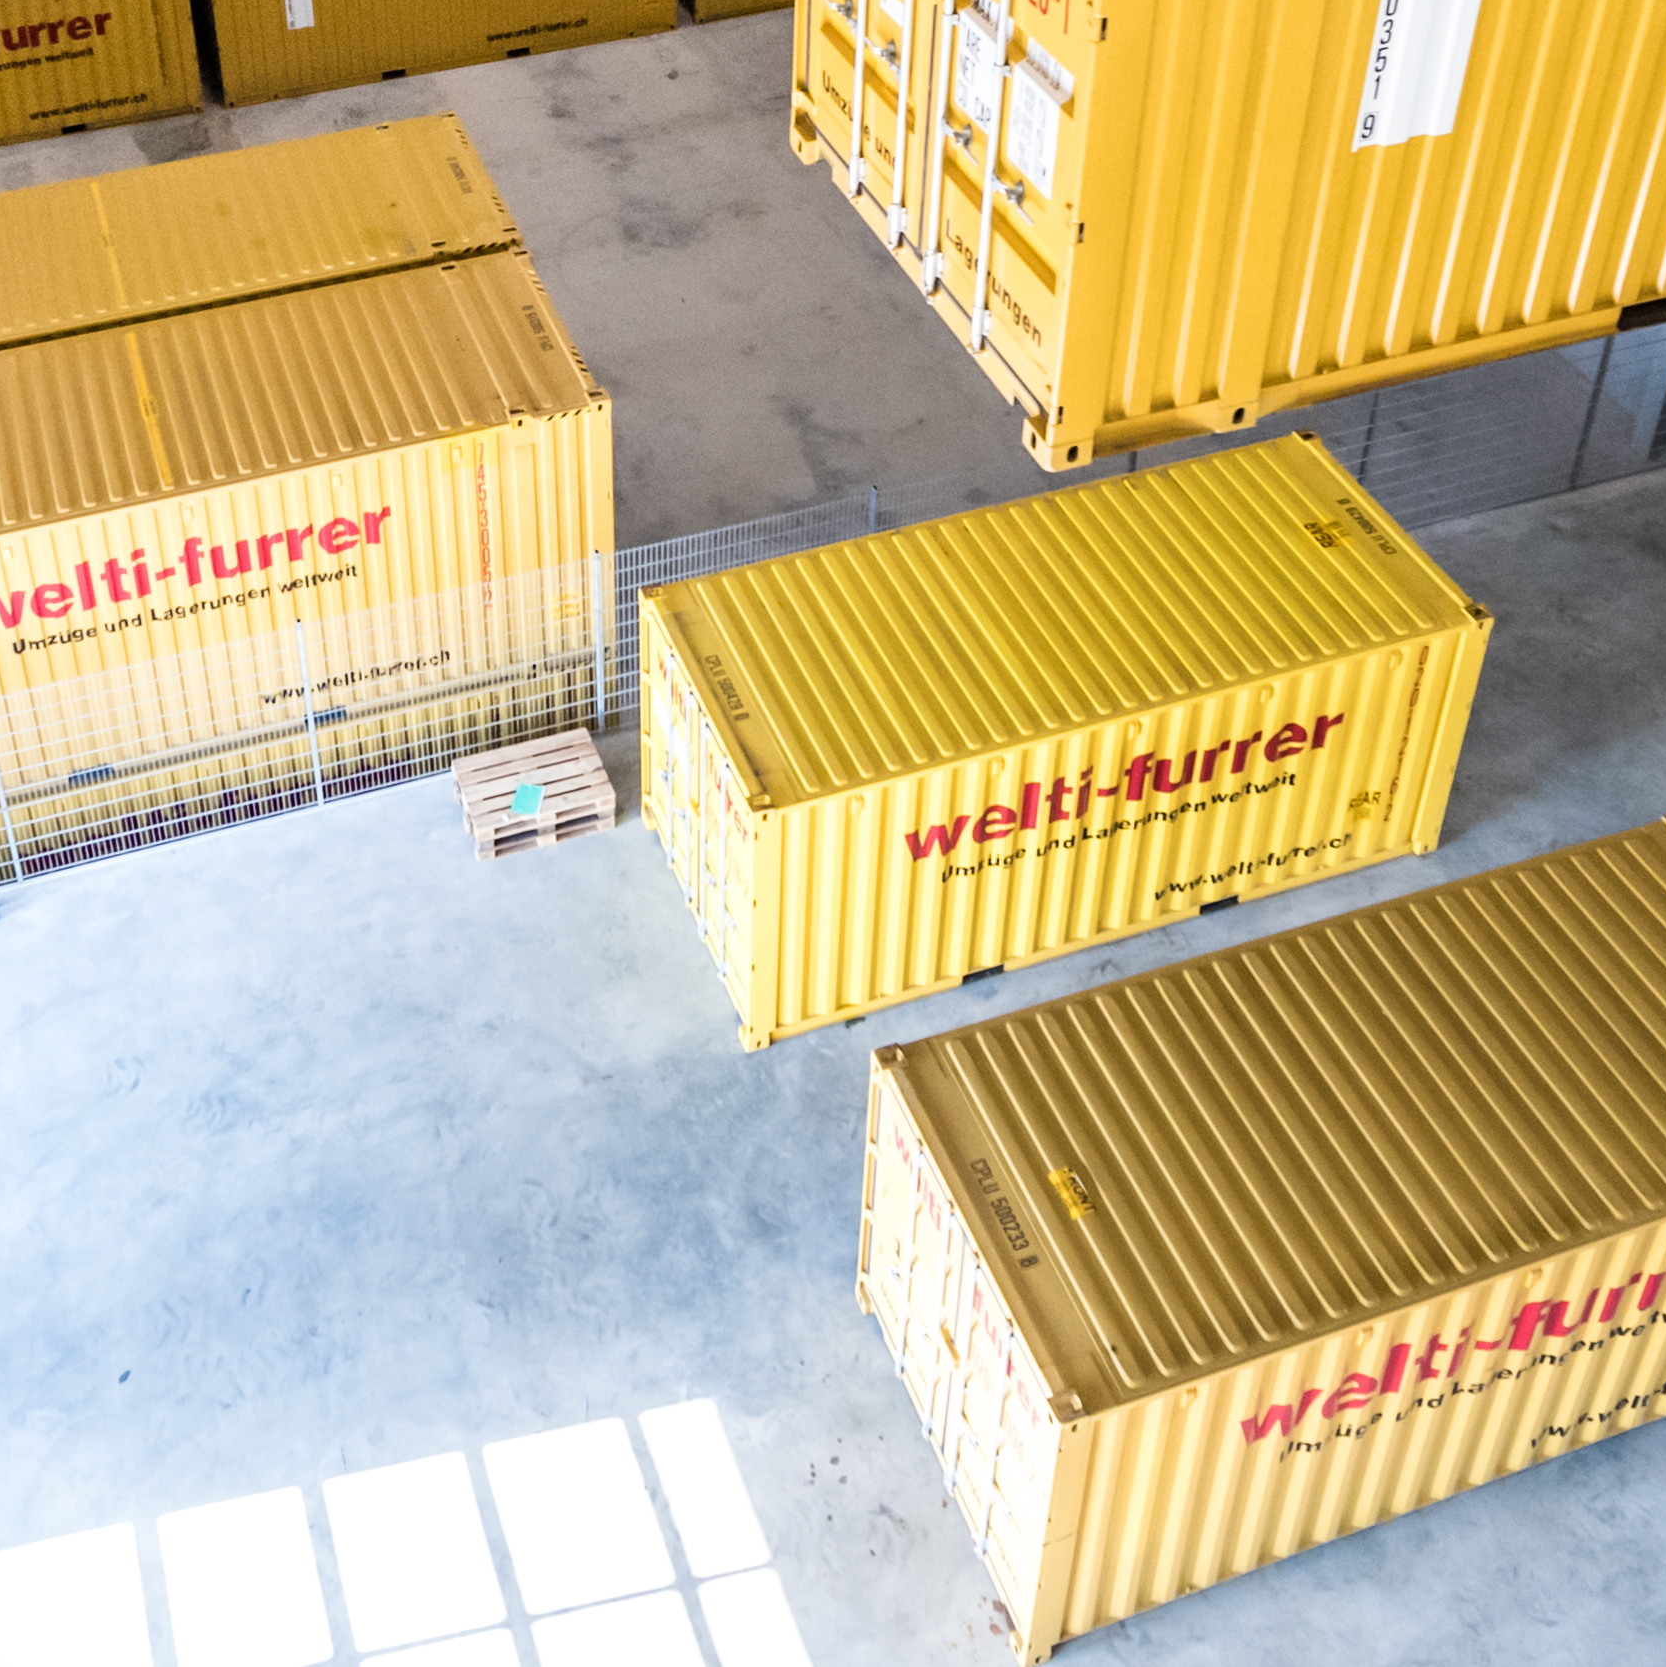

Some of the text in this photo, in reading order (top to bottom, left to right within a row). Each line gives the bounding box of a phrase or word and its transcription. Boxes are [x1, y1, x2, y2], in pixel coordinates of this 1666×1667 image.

[1361, 114, 1375, 139] 9
[12, 564, 357, 655] Umzüge und Lagerungen weltweit
[905, 712, 1344, 862] welti-furrer
[970, 1157, 1001, 1195] CPLU
[990, 1196, 1030, 1251] 500233
